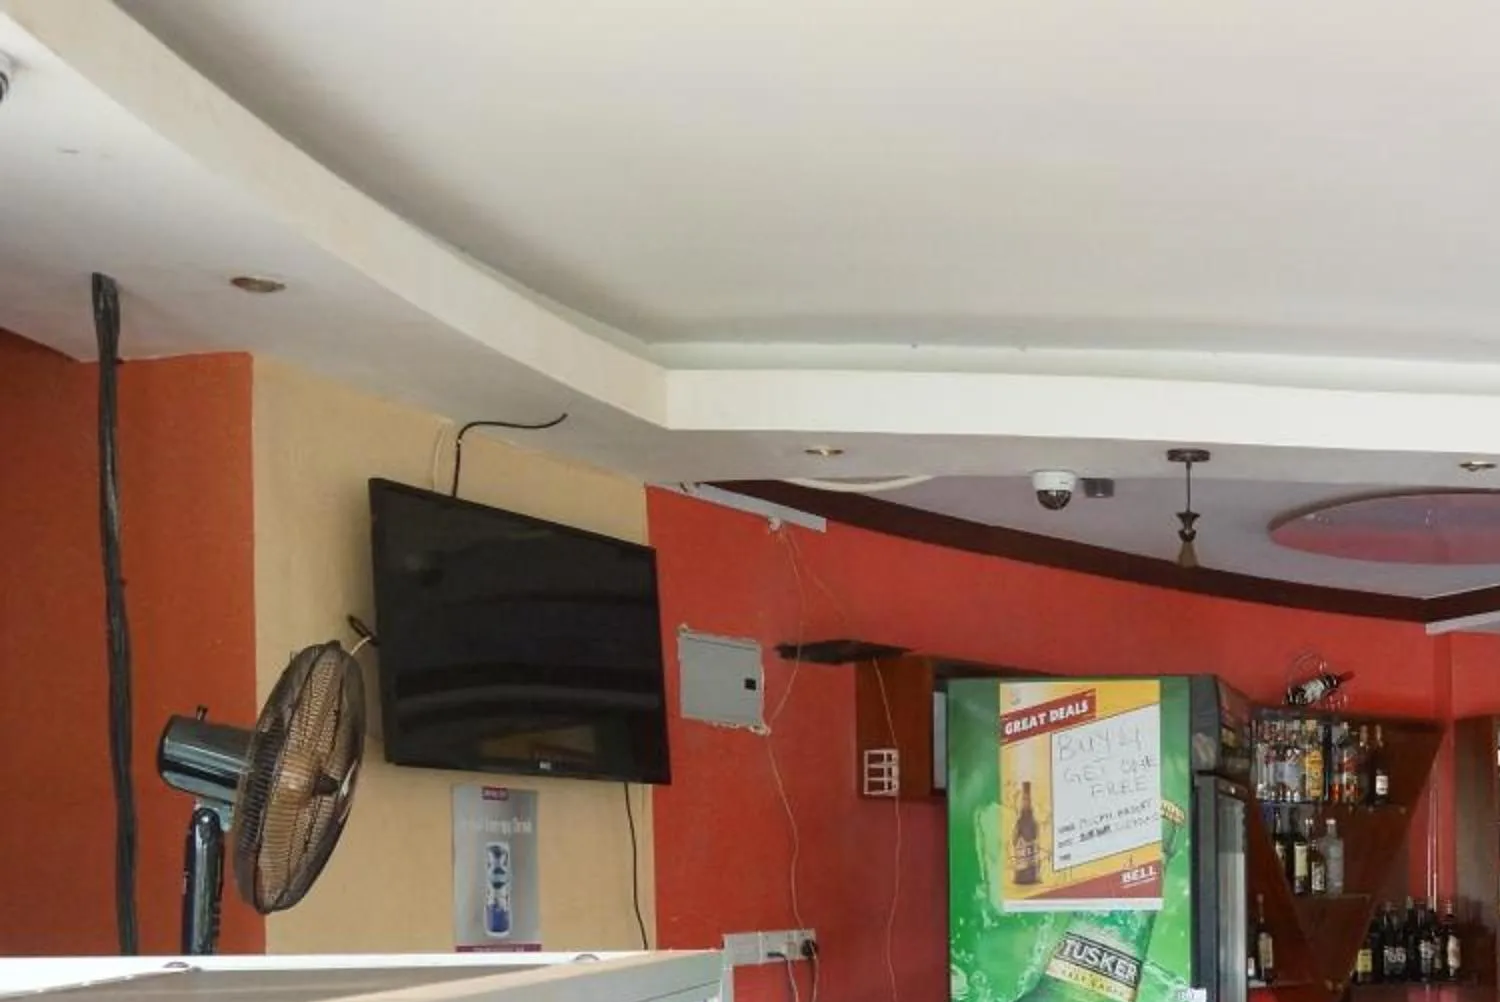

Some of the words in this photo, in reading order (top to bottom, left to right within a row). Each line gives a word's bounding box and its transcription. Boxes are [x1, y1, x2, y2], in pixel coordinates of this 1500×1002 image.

[1004, 714, 1047, 736] GREAT
[1050, 700, 1089, 723] DEALS
[1120, 865, 1157, 883] BELL
[1062, 938, 1138, 984] TUSKER
